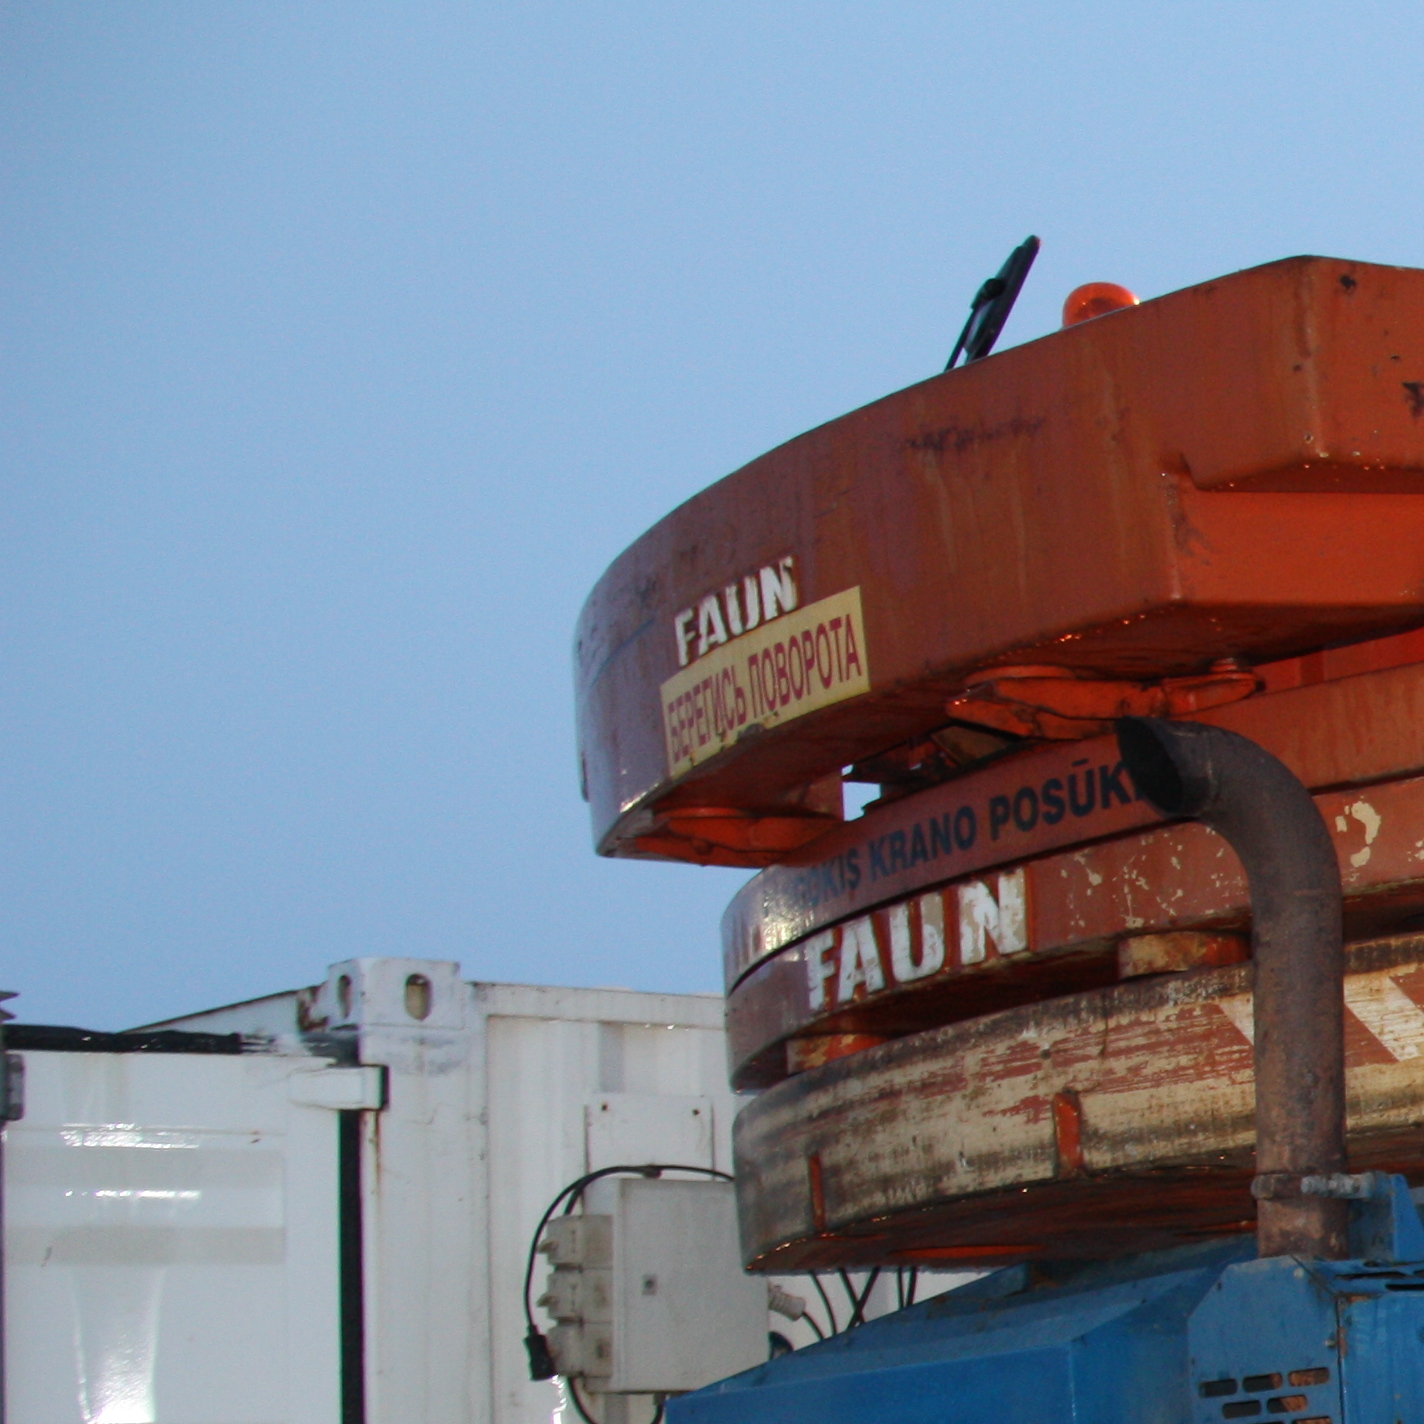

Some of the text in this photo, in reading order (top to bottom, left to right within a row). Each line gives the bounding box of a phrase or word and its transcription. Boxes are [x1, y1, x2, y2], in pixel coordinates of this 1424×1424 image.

[675, 556, 798, 667] FAUN
[668, 614, 862, 764] БЕРЕГИСЬ ПОВОРОТА
[868, 805, 976, 881] KRANO
[989, 758, 1142, 841] POSŪK
[806, 867, 1029, 1011] FAUN
